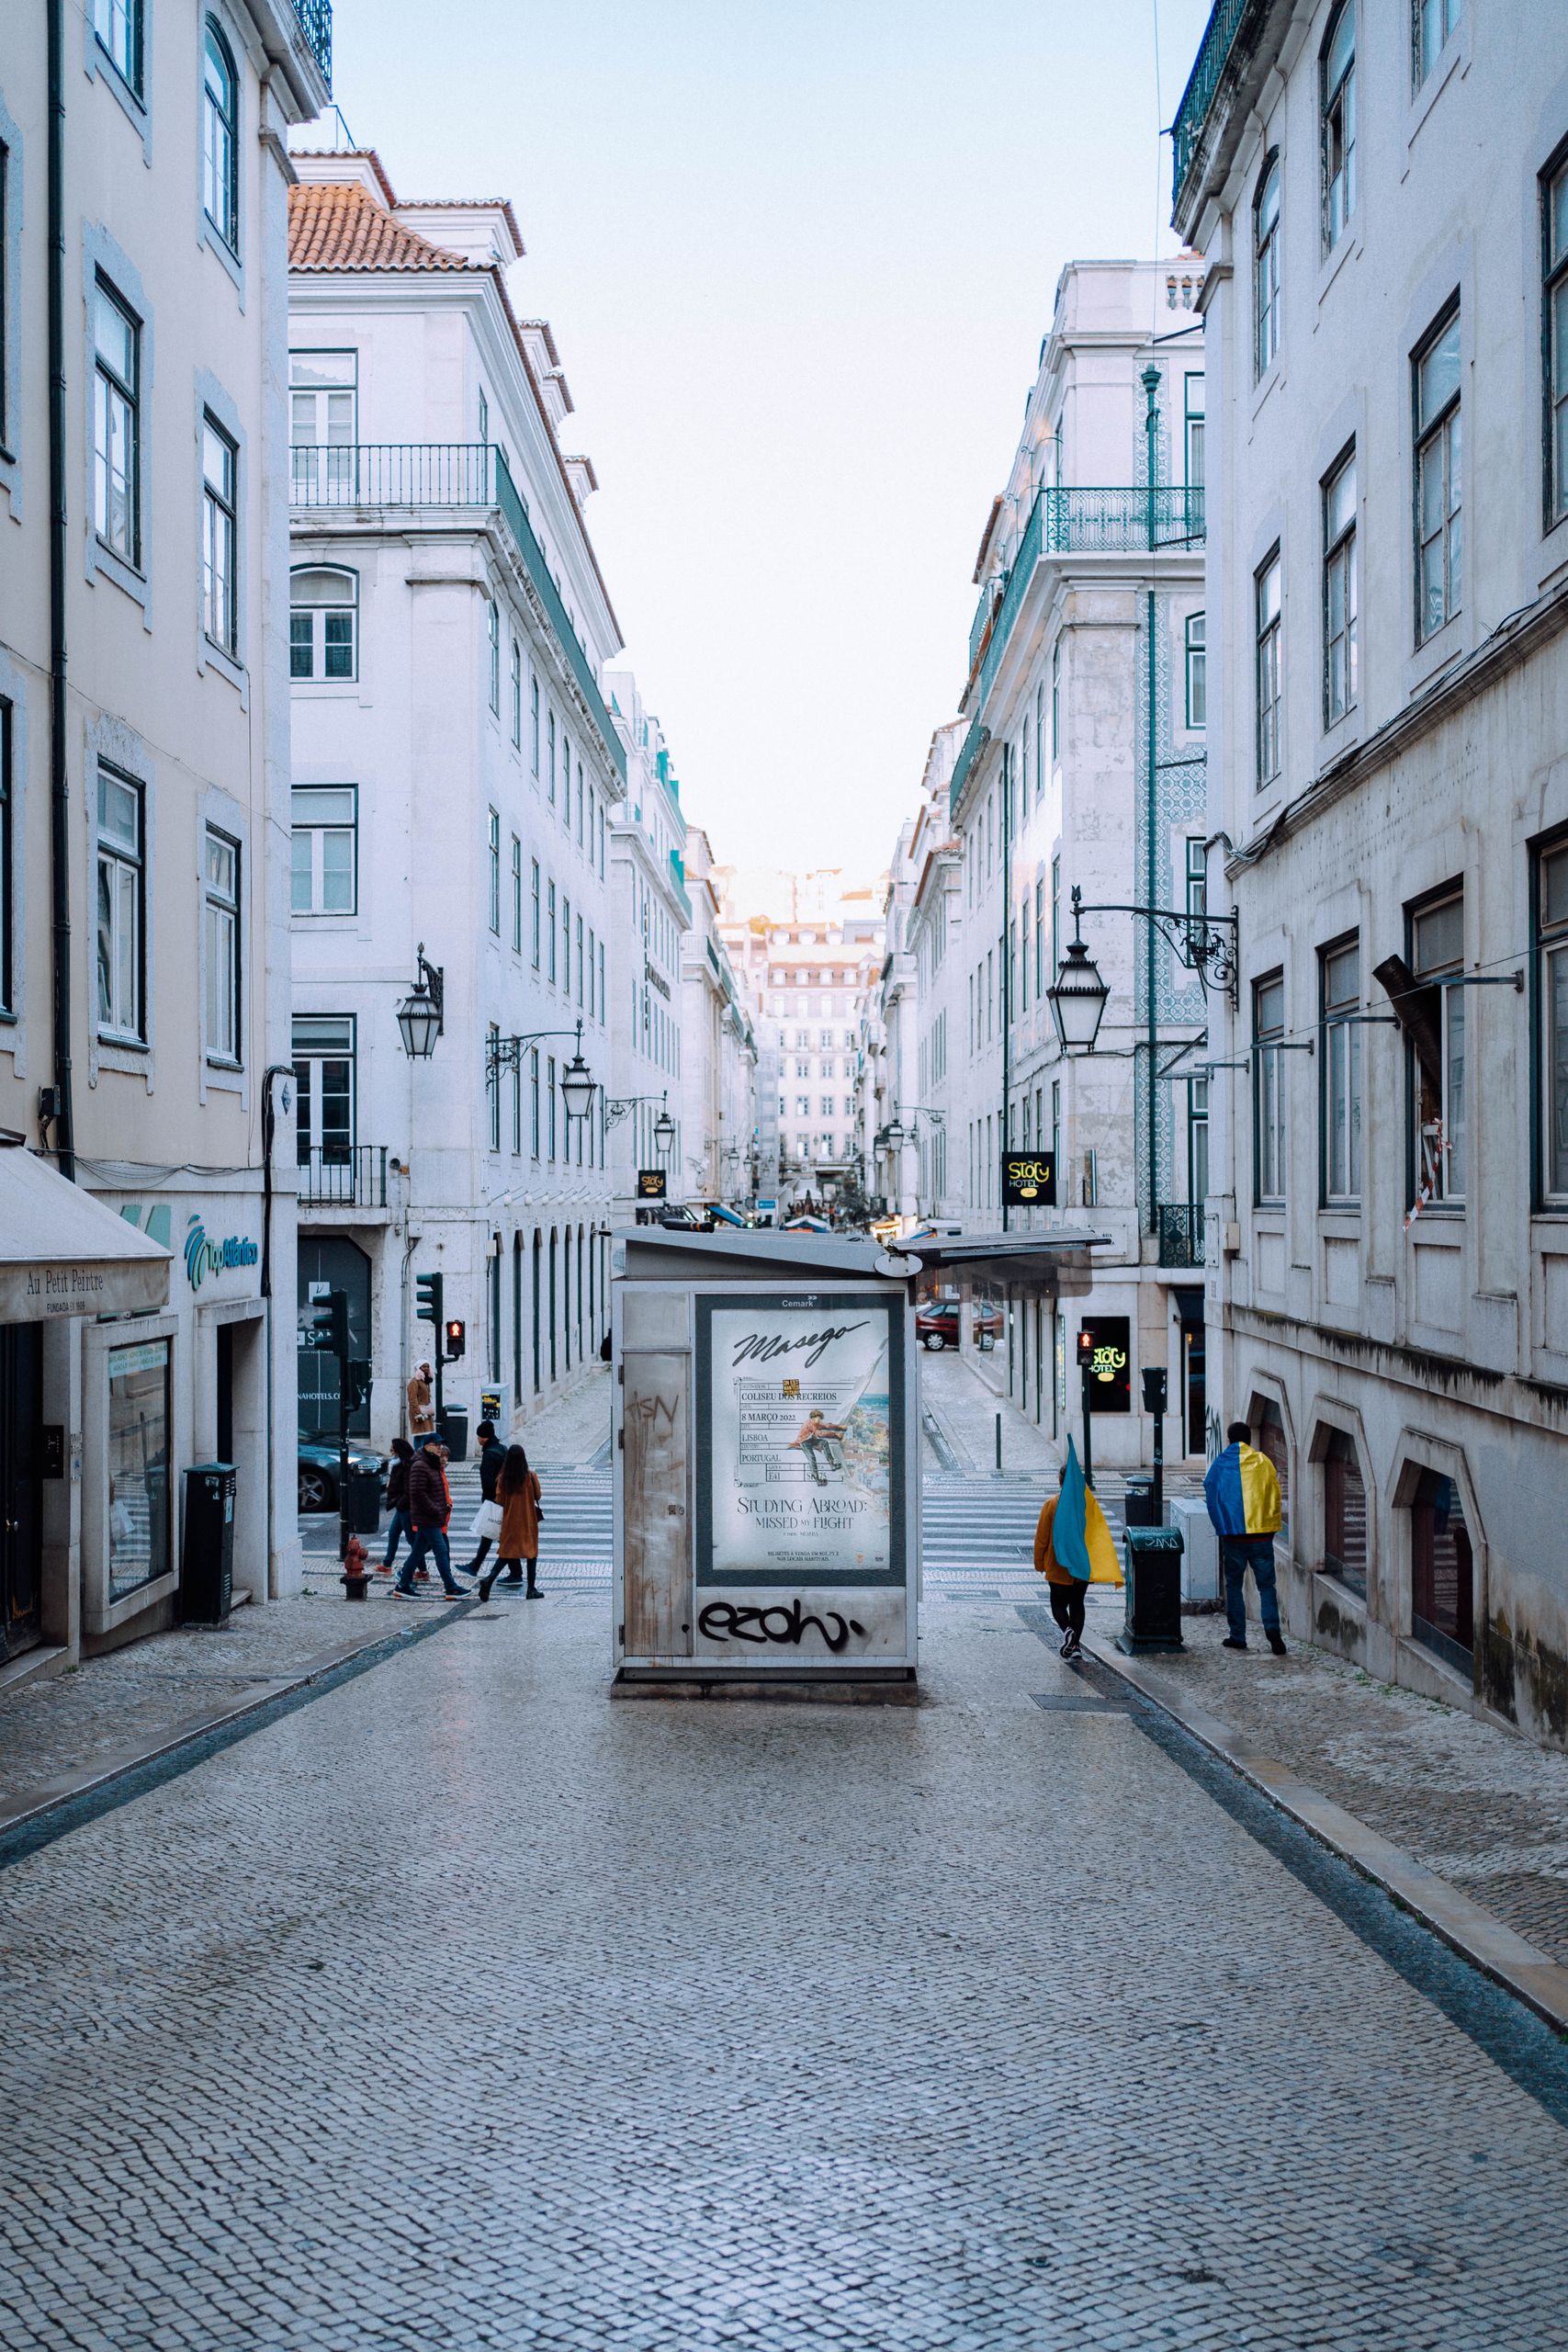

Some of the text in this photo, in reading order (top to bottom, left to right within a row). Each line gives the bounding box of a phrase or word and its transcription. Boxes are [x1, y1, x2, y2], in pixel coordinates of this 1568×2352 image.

[27, 1269, 103, 1295] Au Petit Peintre
[783, 1299, 813, 1307] Cemark
[732, 1321, 871, 1369] Masego
[741, 1392, 837, 1401] COLISEU DOS RECREIOS
[741, 1413, 747, 1421] 8
[748, 1413, 777, 1424] MARÇO
[741, 1454, 781, 1463] PORTUGAL
[756, 1517, 798, 1529] MISSED
[814, 1517, 854, 1530] FLIGHT
